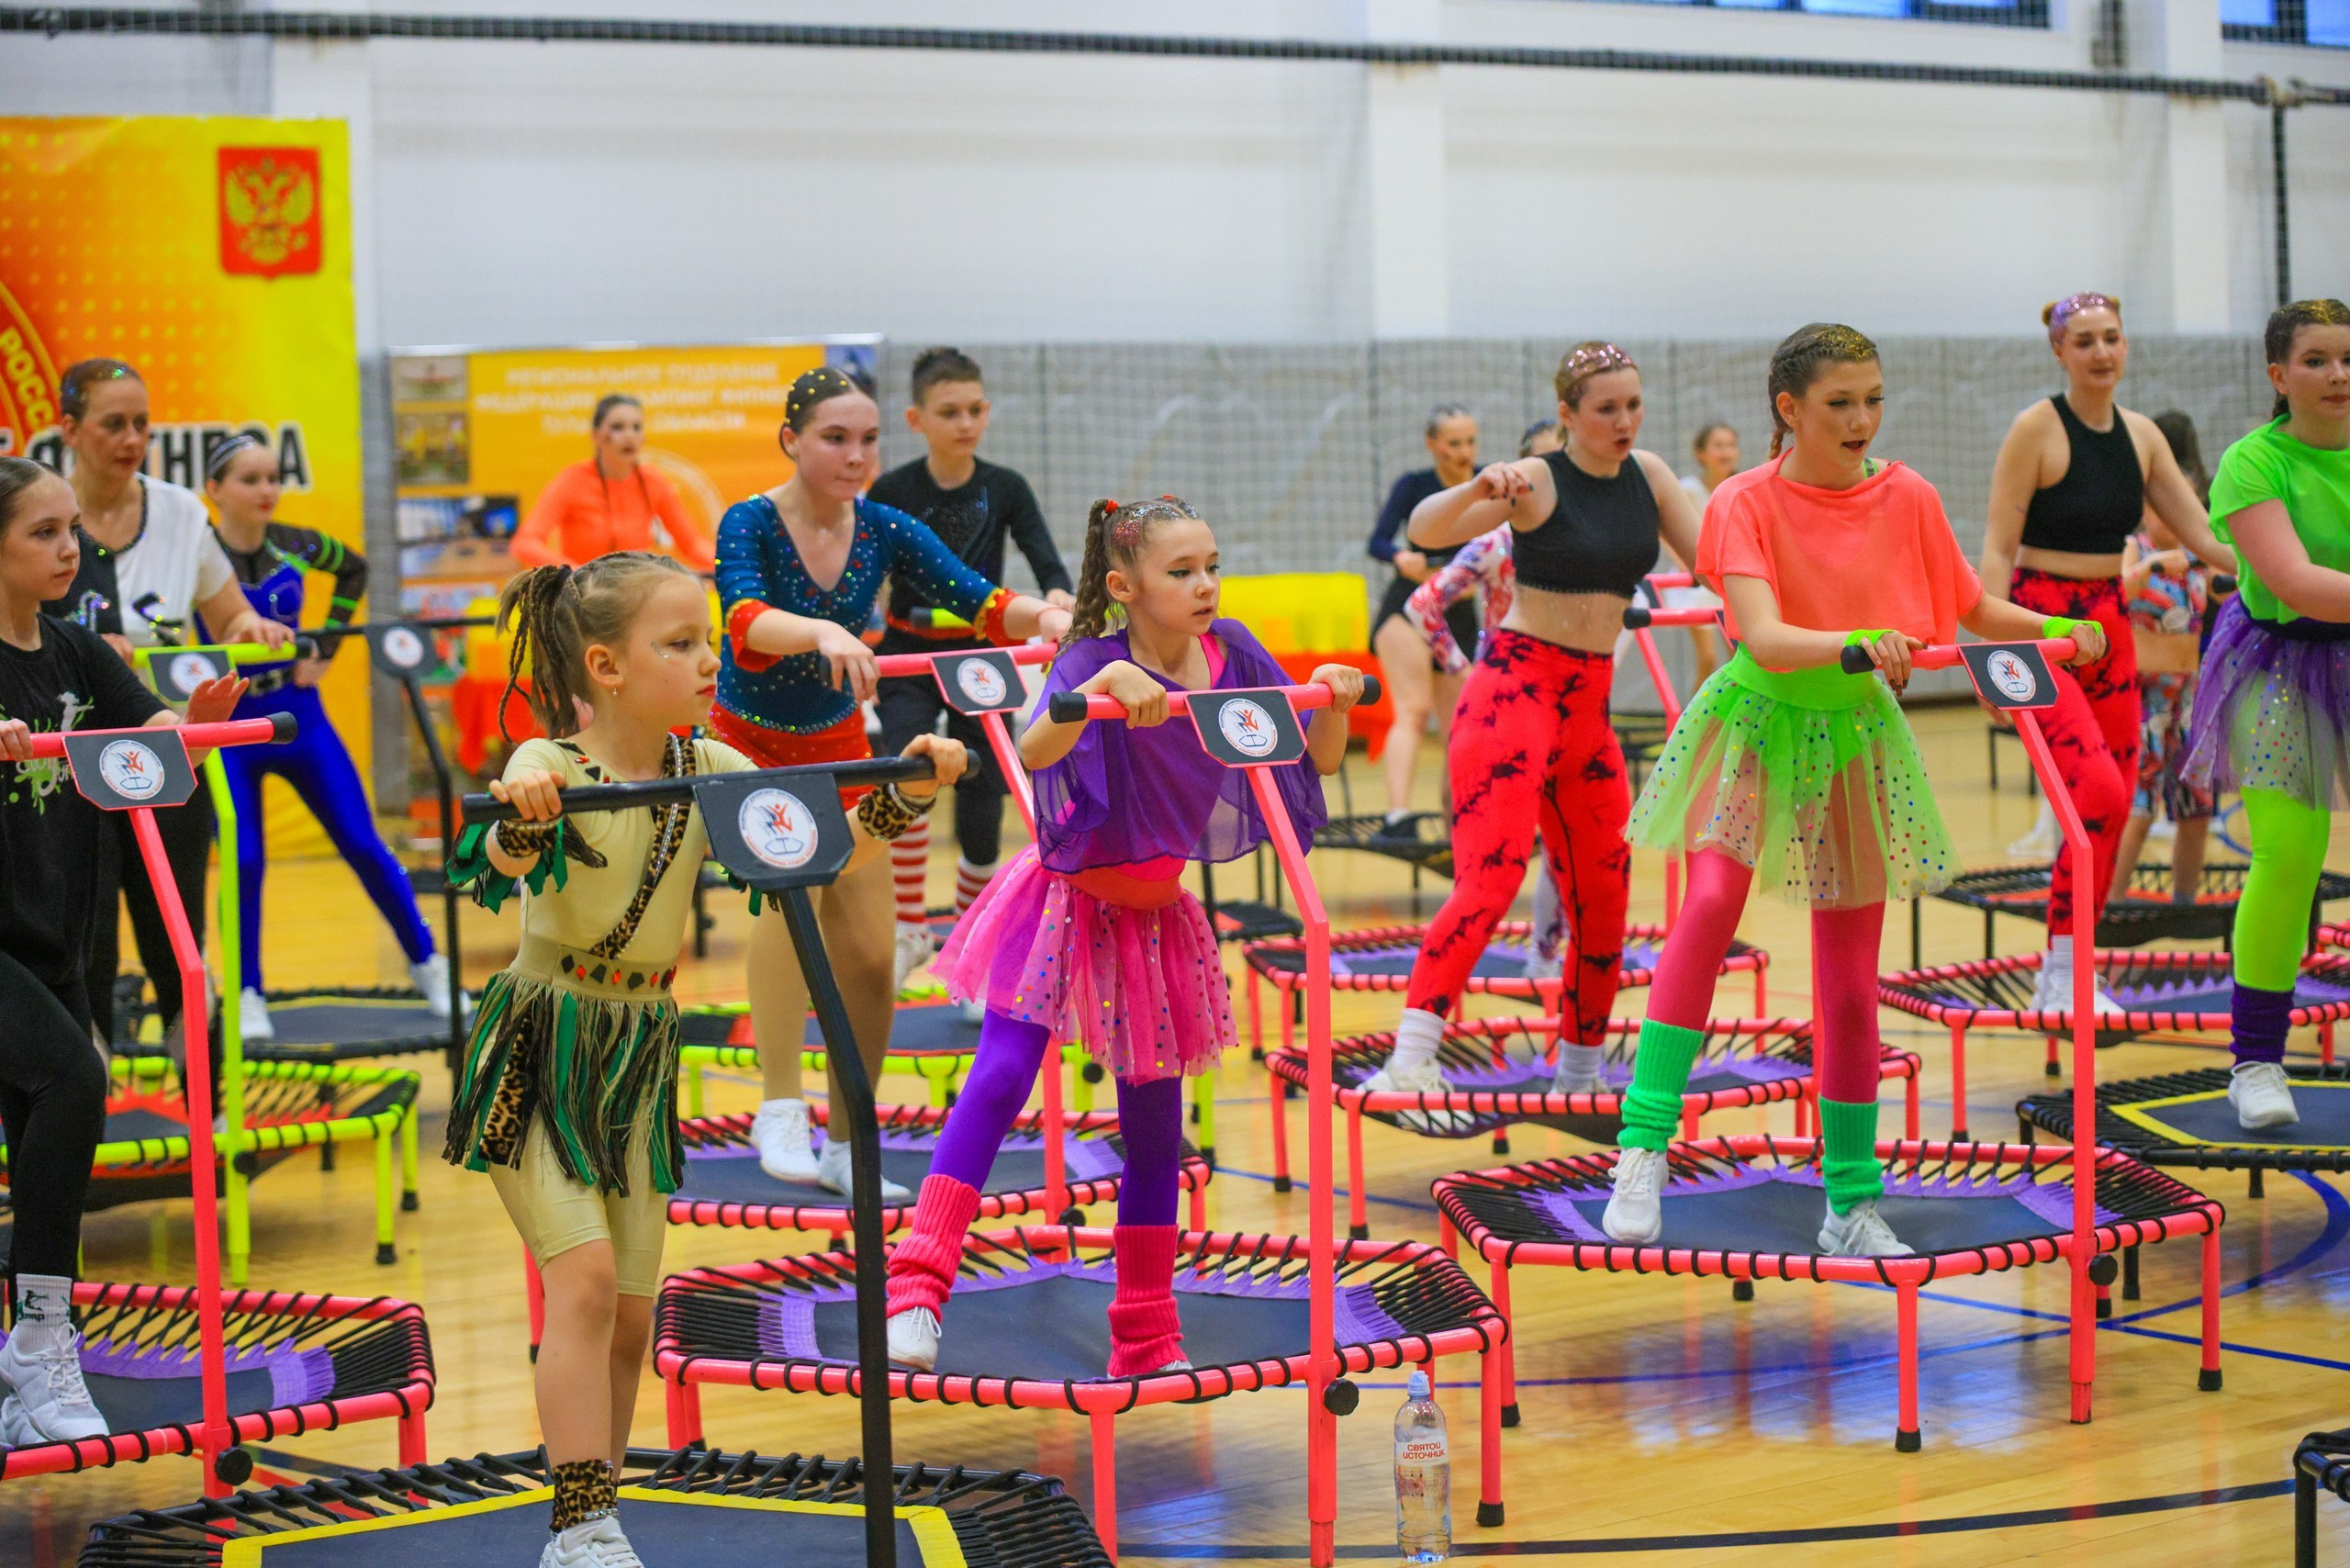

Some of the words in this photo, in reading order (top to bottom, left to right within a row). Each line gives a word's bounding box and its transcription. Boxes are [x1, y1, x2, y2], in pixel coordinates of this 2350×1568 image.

[0, 326, 55, 433] РОСС
[1407, 1441, 1441, 1451] СВЯТОЙ
[1403, 1449, 1446, 1460] ИСТОЧНИК
